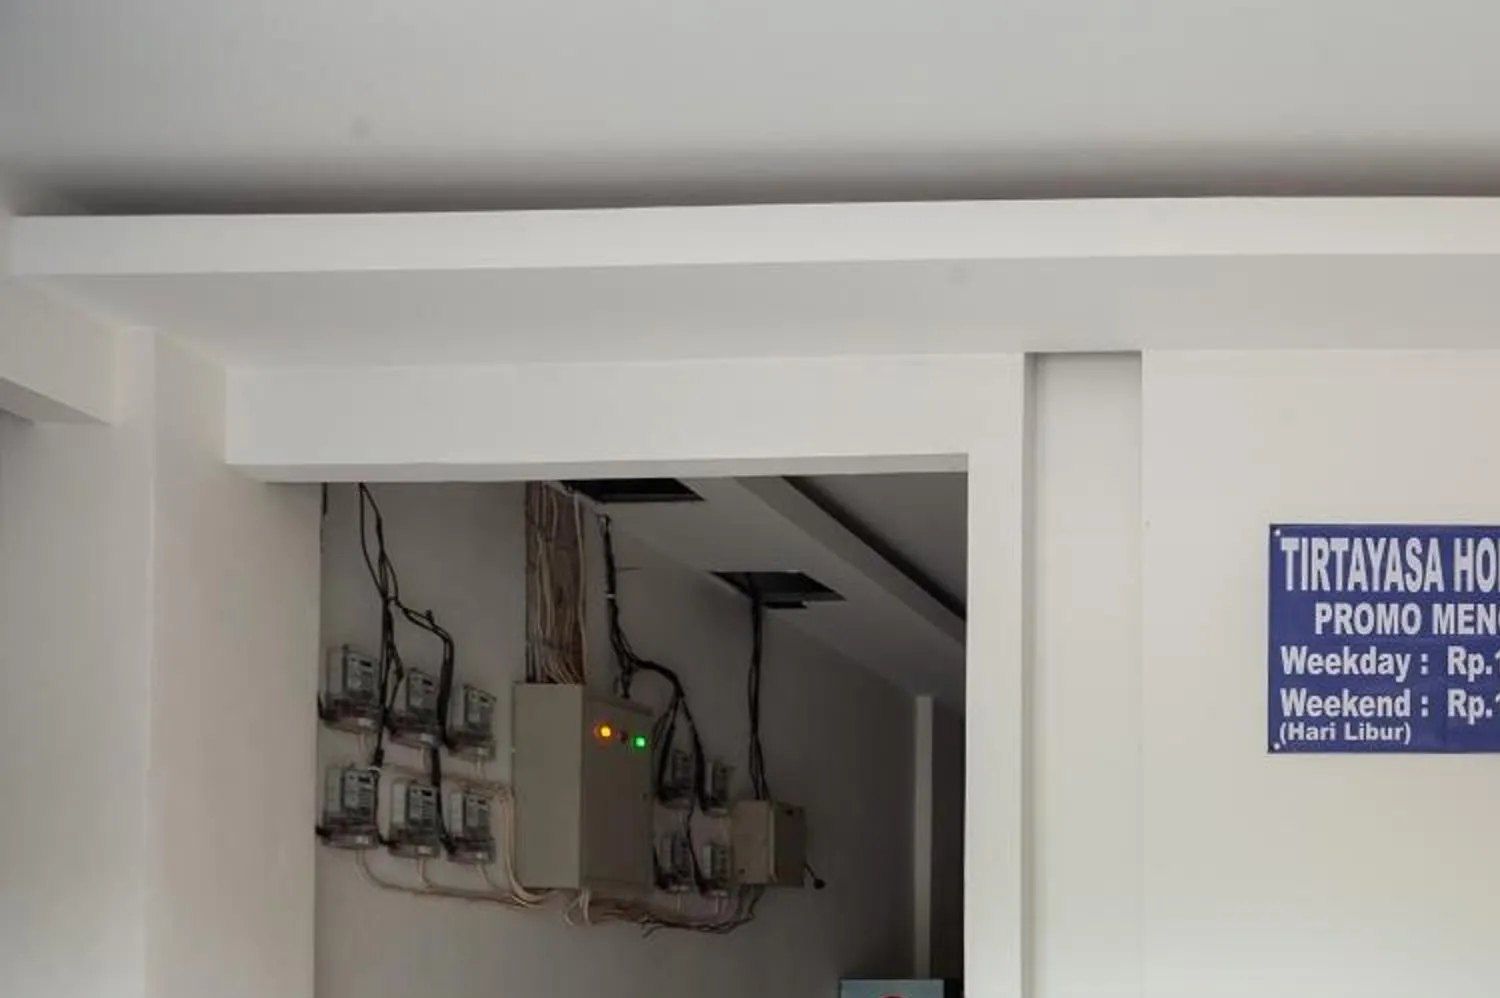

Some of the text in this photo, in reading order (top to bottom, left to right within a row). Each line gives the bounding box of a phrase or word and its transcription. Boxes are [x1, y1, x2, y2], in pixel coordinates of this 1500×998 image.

[1281, 537, 1445, 592] TIRTAYASA
[1315, 603, 1422, 635] PROMO
[1280, 645, 1411, 683] Weekday
[1280, 688, 1411, 717] Weekend
[1279, 722, 1411, 745] (Hari Libur)
